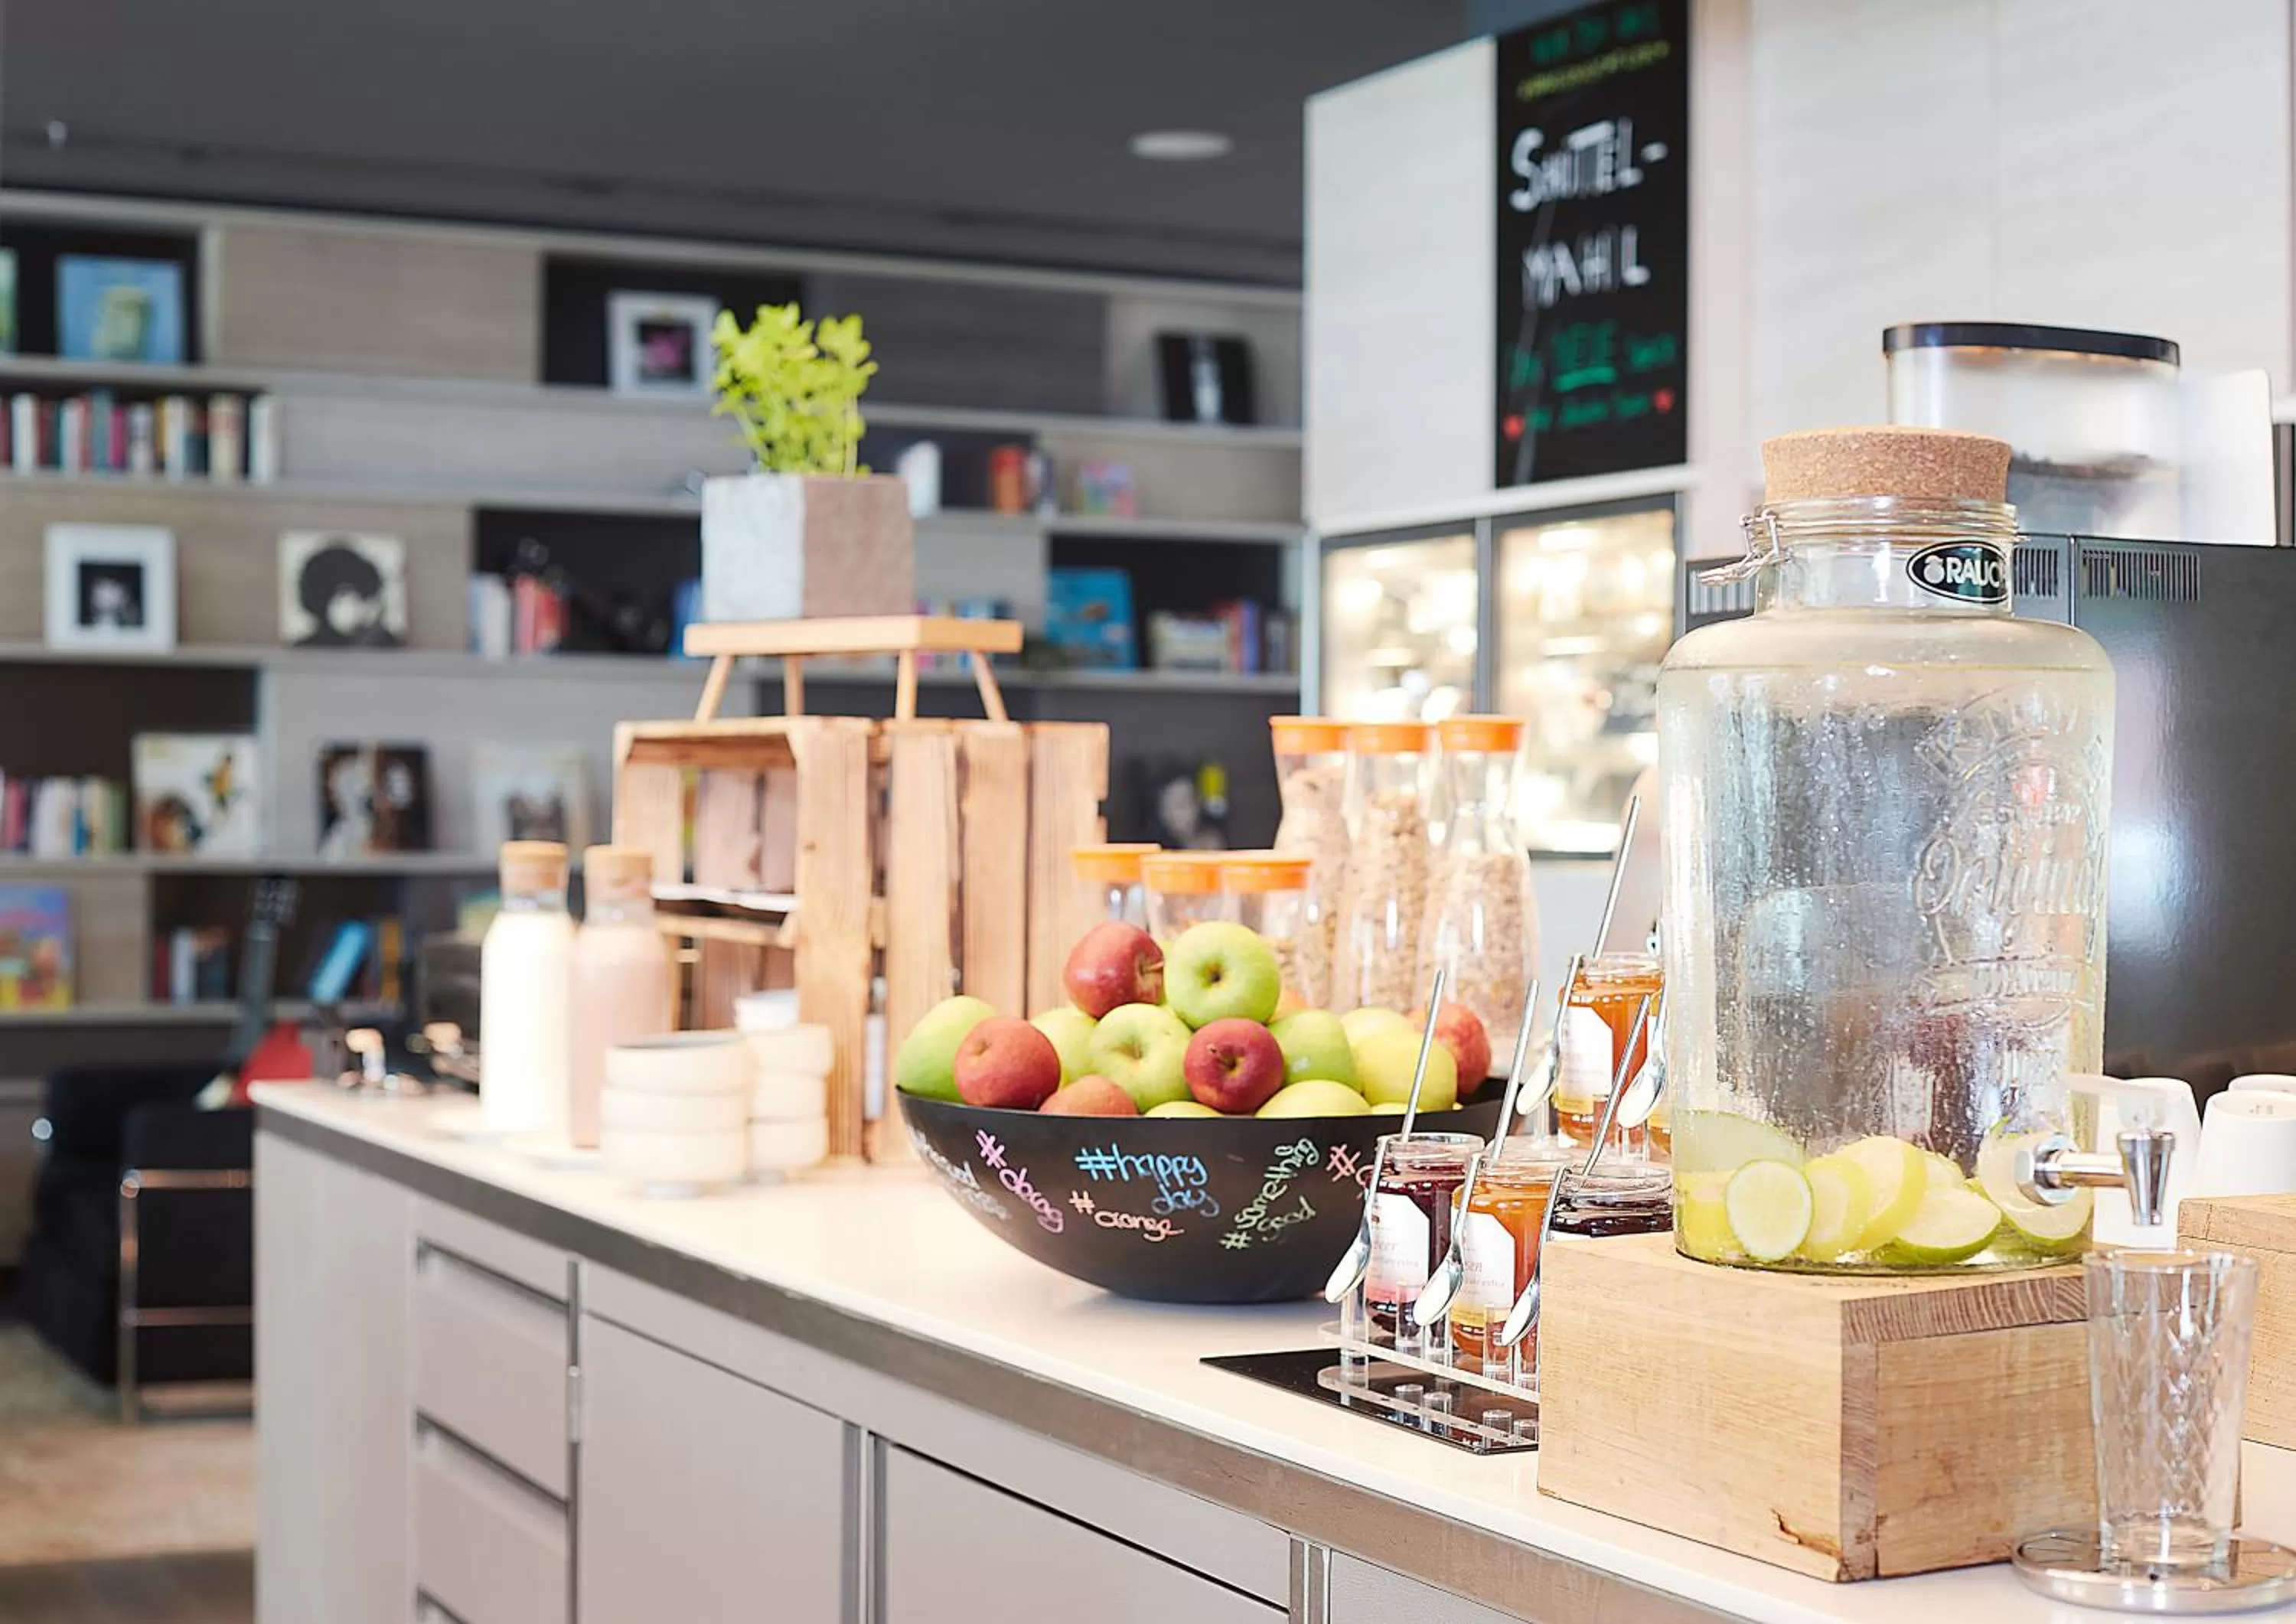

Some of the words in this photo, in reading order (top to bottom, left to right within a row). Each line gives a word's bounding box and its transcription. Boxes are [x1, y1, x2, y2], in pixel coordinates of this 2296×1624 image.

[1946, 556, 2002, 588] RAUC
[1075, 1143, 1208, 1187] #happy
[1151, 1183, 1220, 1217] day
